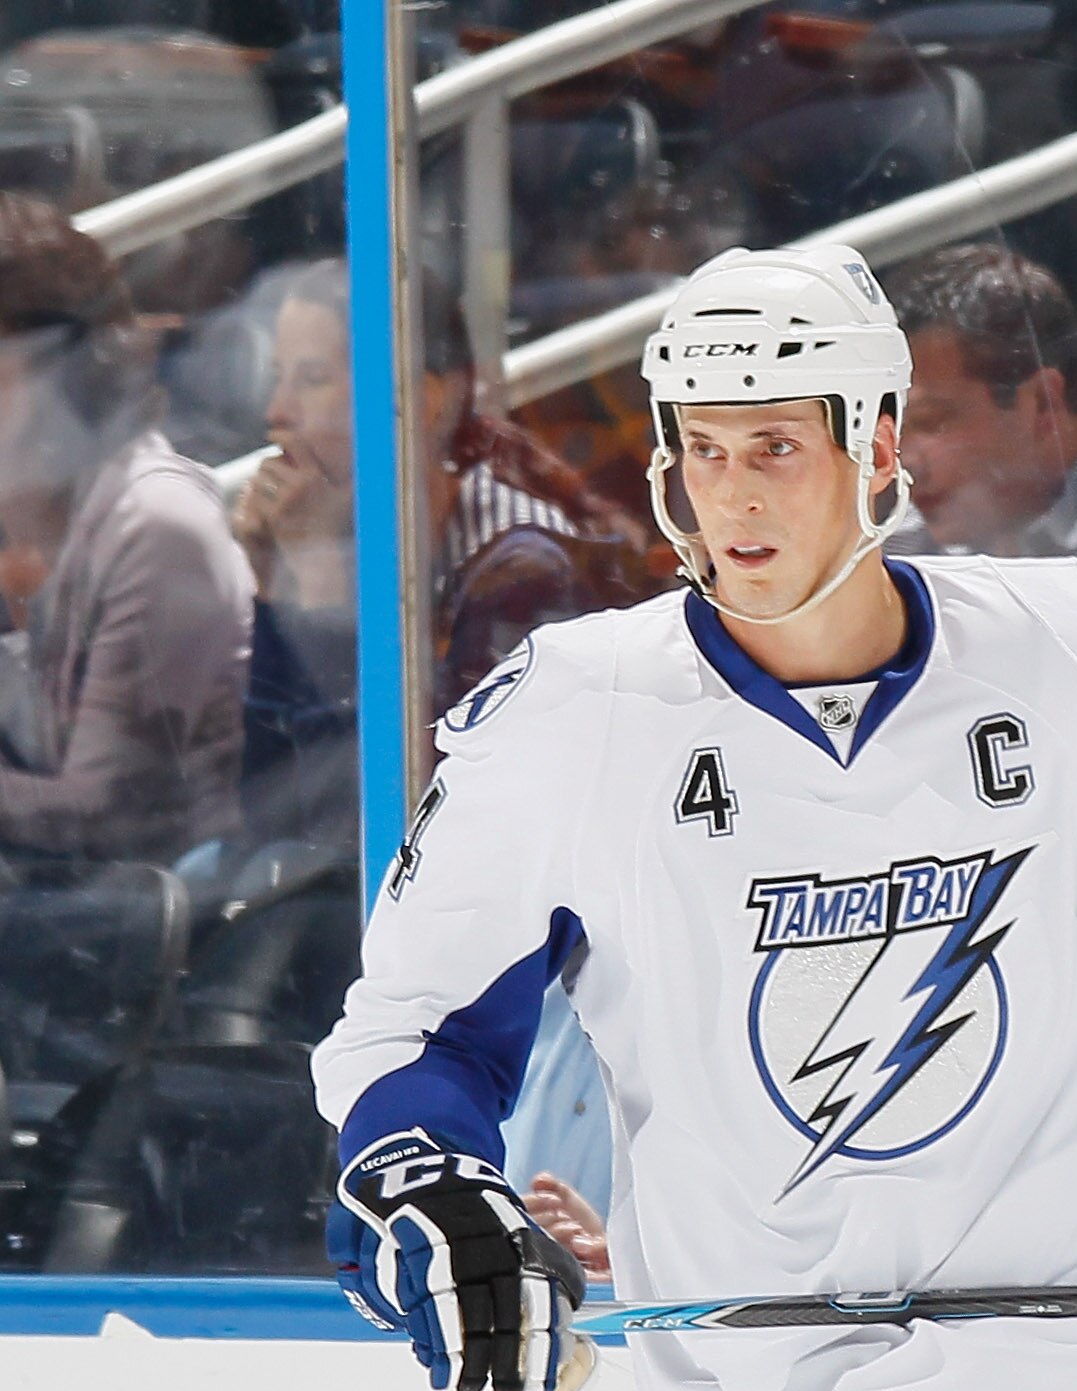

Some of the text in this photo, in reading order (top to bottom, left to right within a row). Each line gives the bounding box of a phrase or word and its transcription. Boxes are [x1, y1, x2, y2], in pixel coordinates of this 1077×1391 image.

[684, 343, 760, 358] CCM
[674, 747, 739, 837] 4
[967, 712, 1035, 808] C
